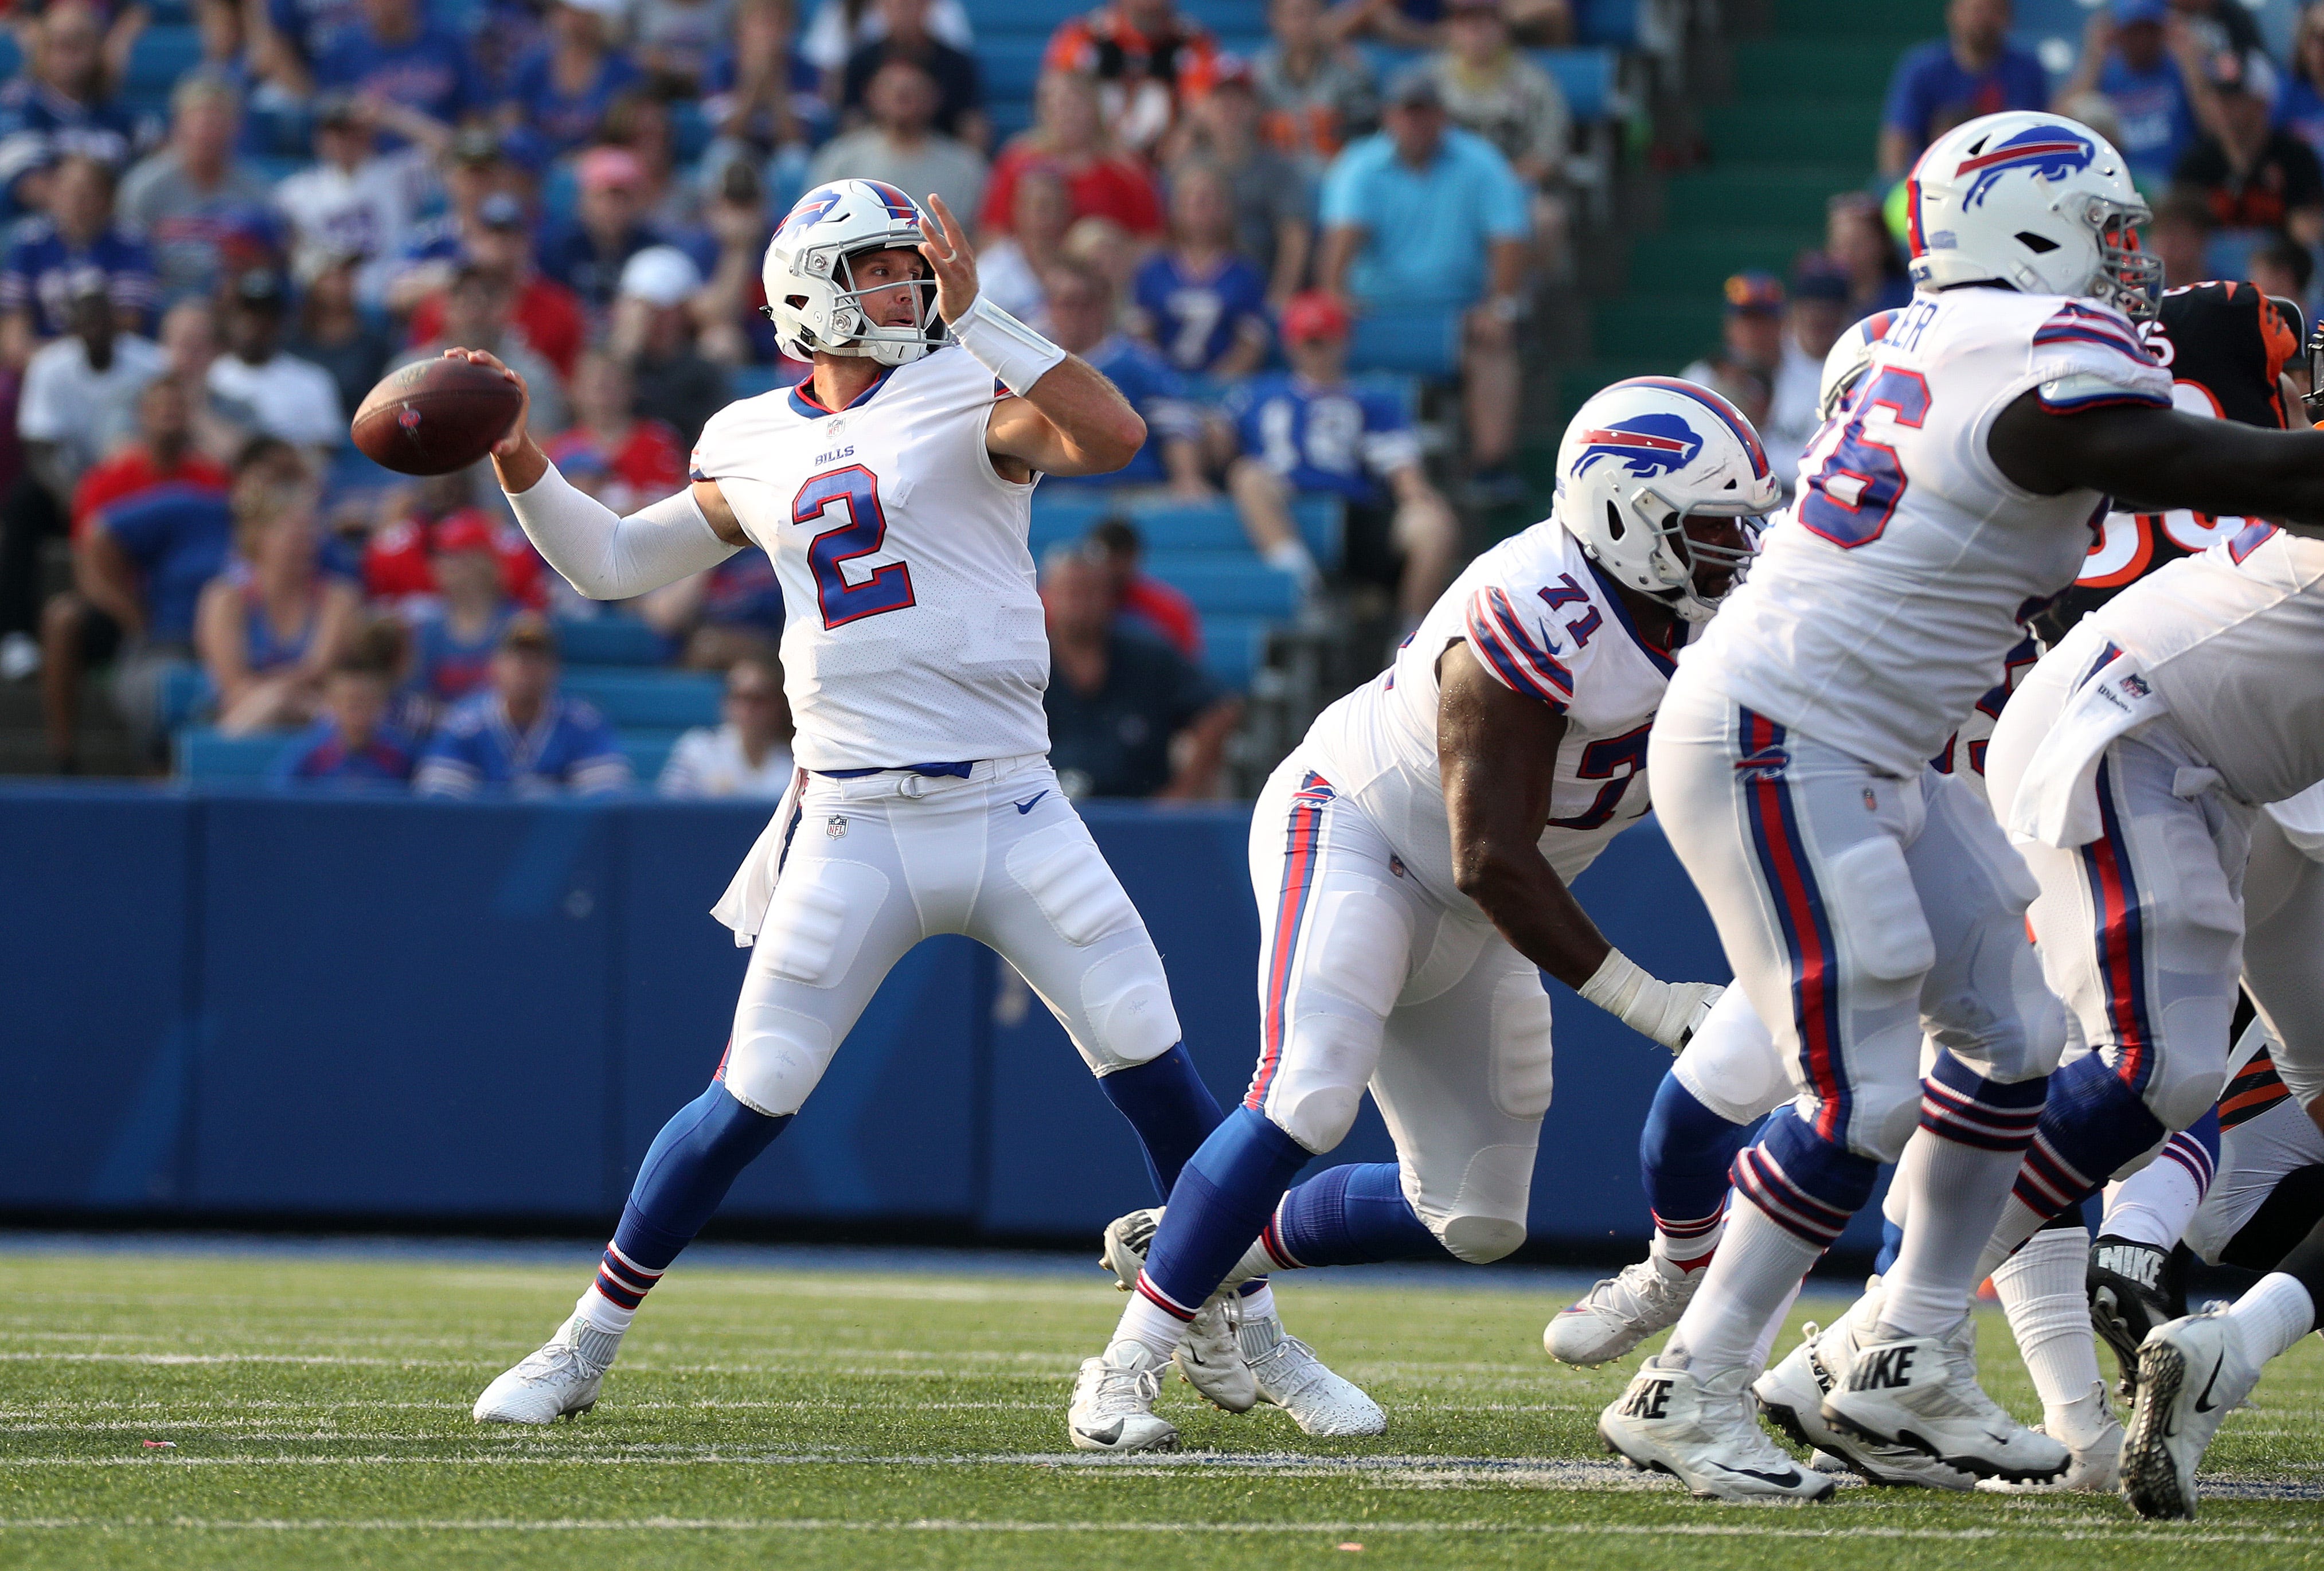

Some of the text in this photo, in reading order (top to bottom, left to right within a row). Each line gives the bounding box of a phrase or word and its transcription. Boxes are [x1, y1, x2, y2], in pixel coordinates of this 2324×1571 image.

[815, 445, 854, 467] BILLS
[792, 463, 917, 631] 2
[1537, 572, 1604, 650] 71
[829, 825, 843, 835] NFL
[2098, 1245, 2166, 1291] NIKE
